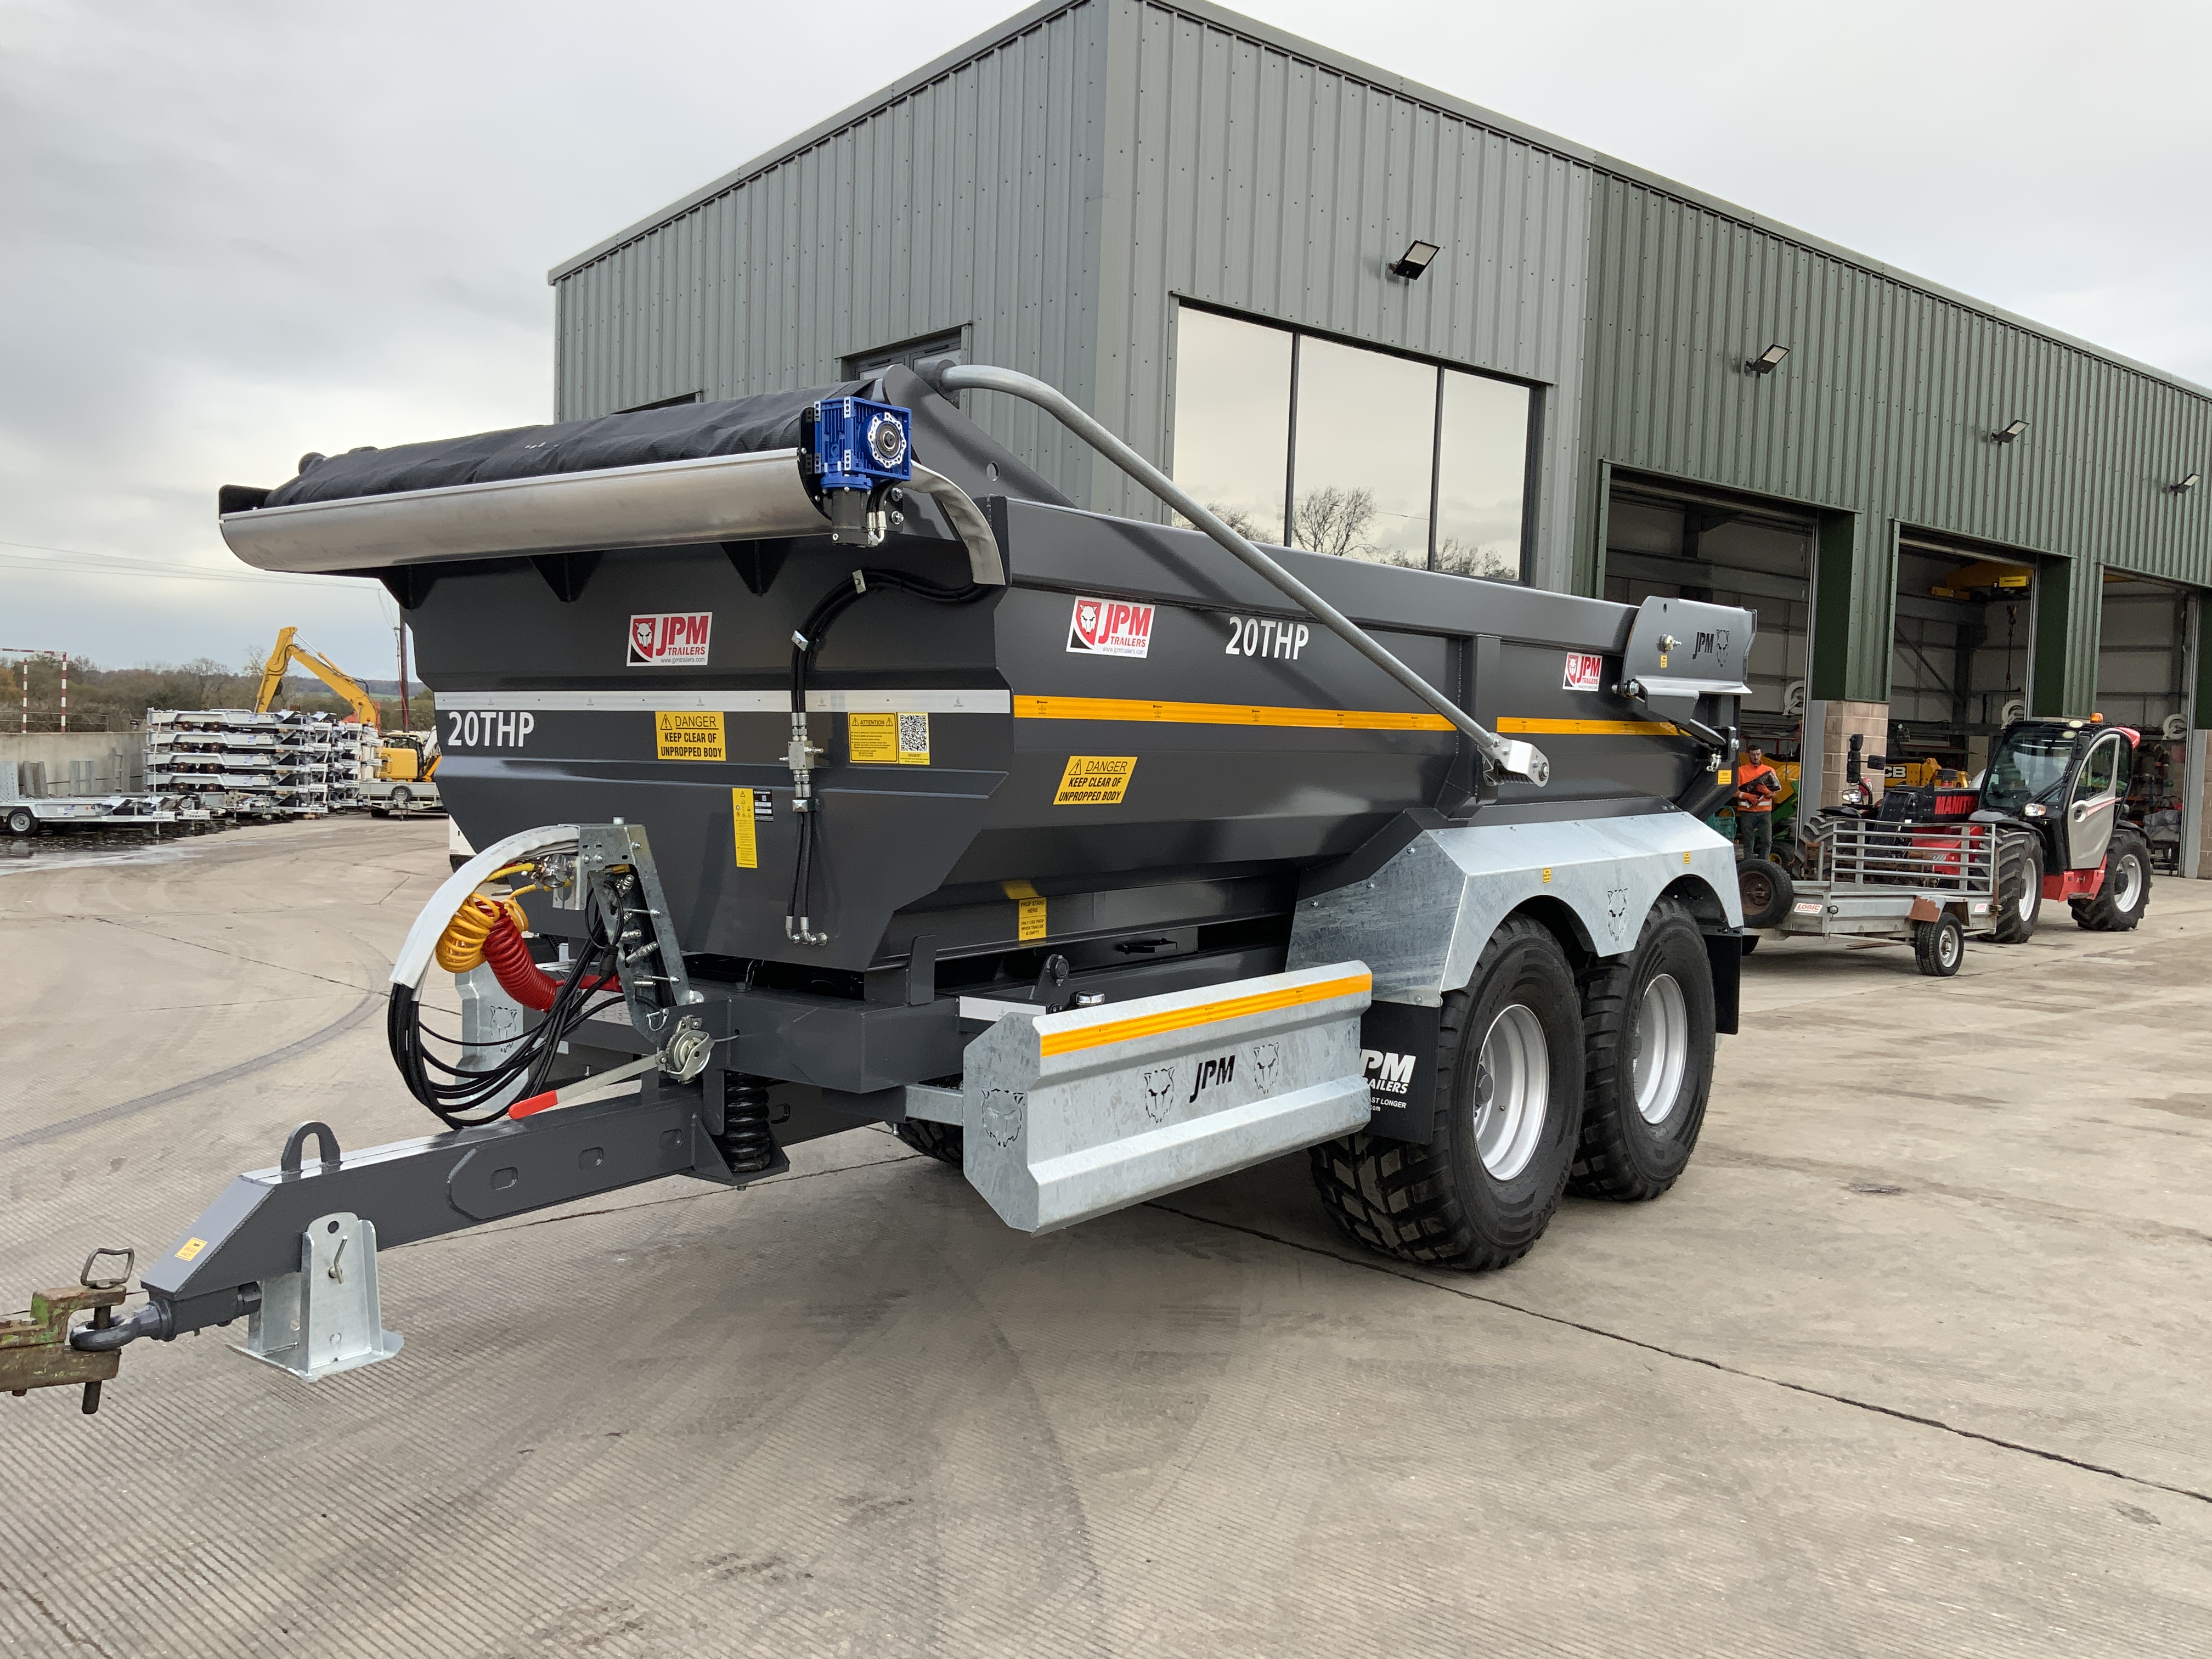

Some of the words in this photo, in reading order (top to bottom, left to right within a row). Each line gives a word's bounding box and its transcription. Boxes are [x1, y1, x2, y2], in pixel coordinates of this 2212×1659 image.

[1097, 603, 1152, 645] JPM
[656, 616, 709, 656] JPM
[1110, 636, 1147, 648] TRAILERS
[1226, 616, 1309, 660] 20THP
[668, 646, 706, 656] TRAILERS
[1102, 646, 1146, 655] www.jpmtrailers.com
[1692, 631, 1715, 660] JPM
[1576, 656, 1601, 684] JPM
[675, 715, 717, 728] DANGER
[448, 711, 535, 747] 20THP
[664, 732, 682, 742] KEEP
[684, 732, 706, 743] CLEAR
[708, 732, 717, 743] OF
[661, 746, 702, 757] UNPROPPED
[703, 747, 723, 758] BODY
[1086, 760, 1128, 772] DANGER
[1885, 766, 1906, 778] CB
[1068, 777, 1088, 788] KEEP
[1088, 777, 1111, 788] CLEAR
[1111, 777, 1122, 787] OF
[1058, 791, 1102, 802] UNPROPPED
[1101, 791, 1122, 801] BODY
[1360, 1048, 1417, 1084] PM
[1189, 1054, 1236, 1104] JPM
[1363, 1077, 1409, 1094] AILERS
[1380, 1098, 1407, 1109] LONGER
